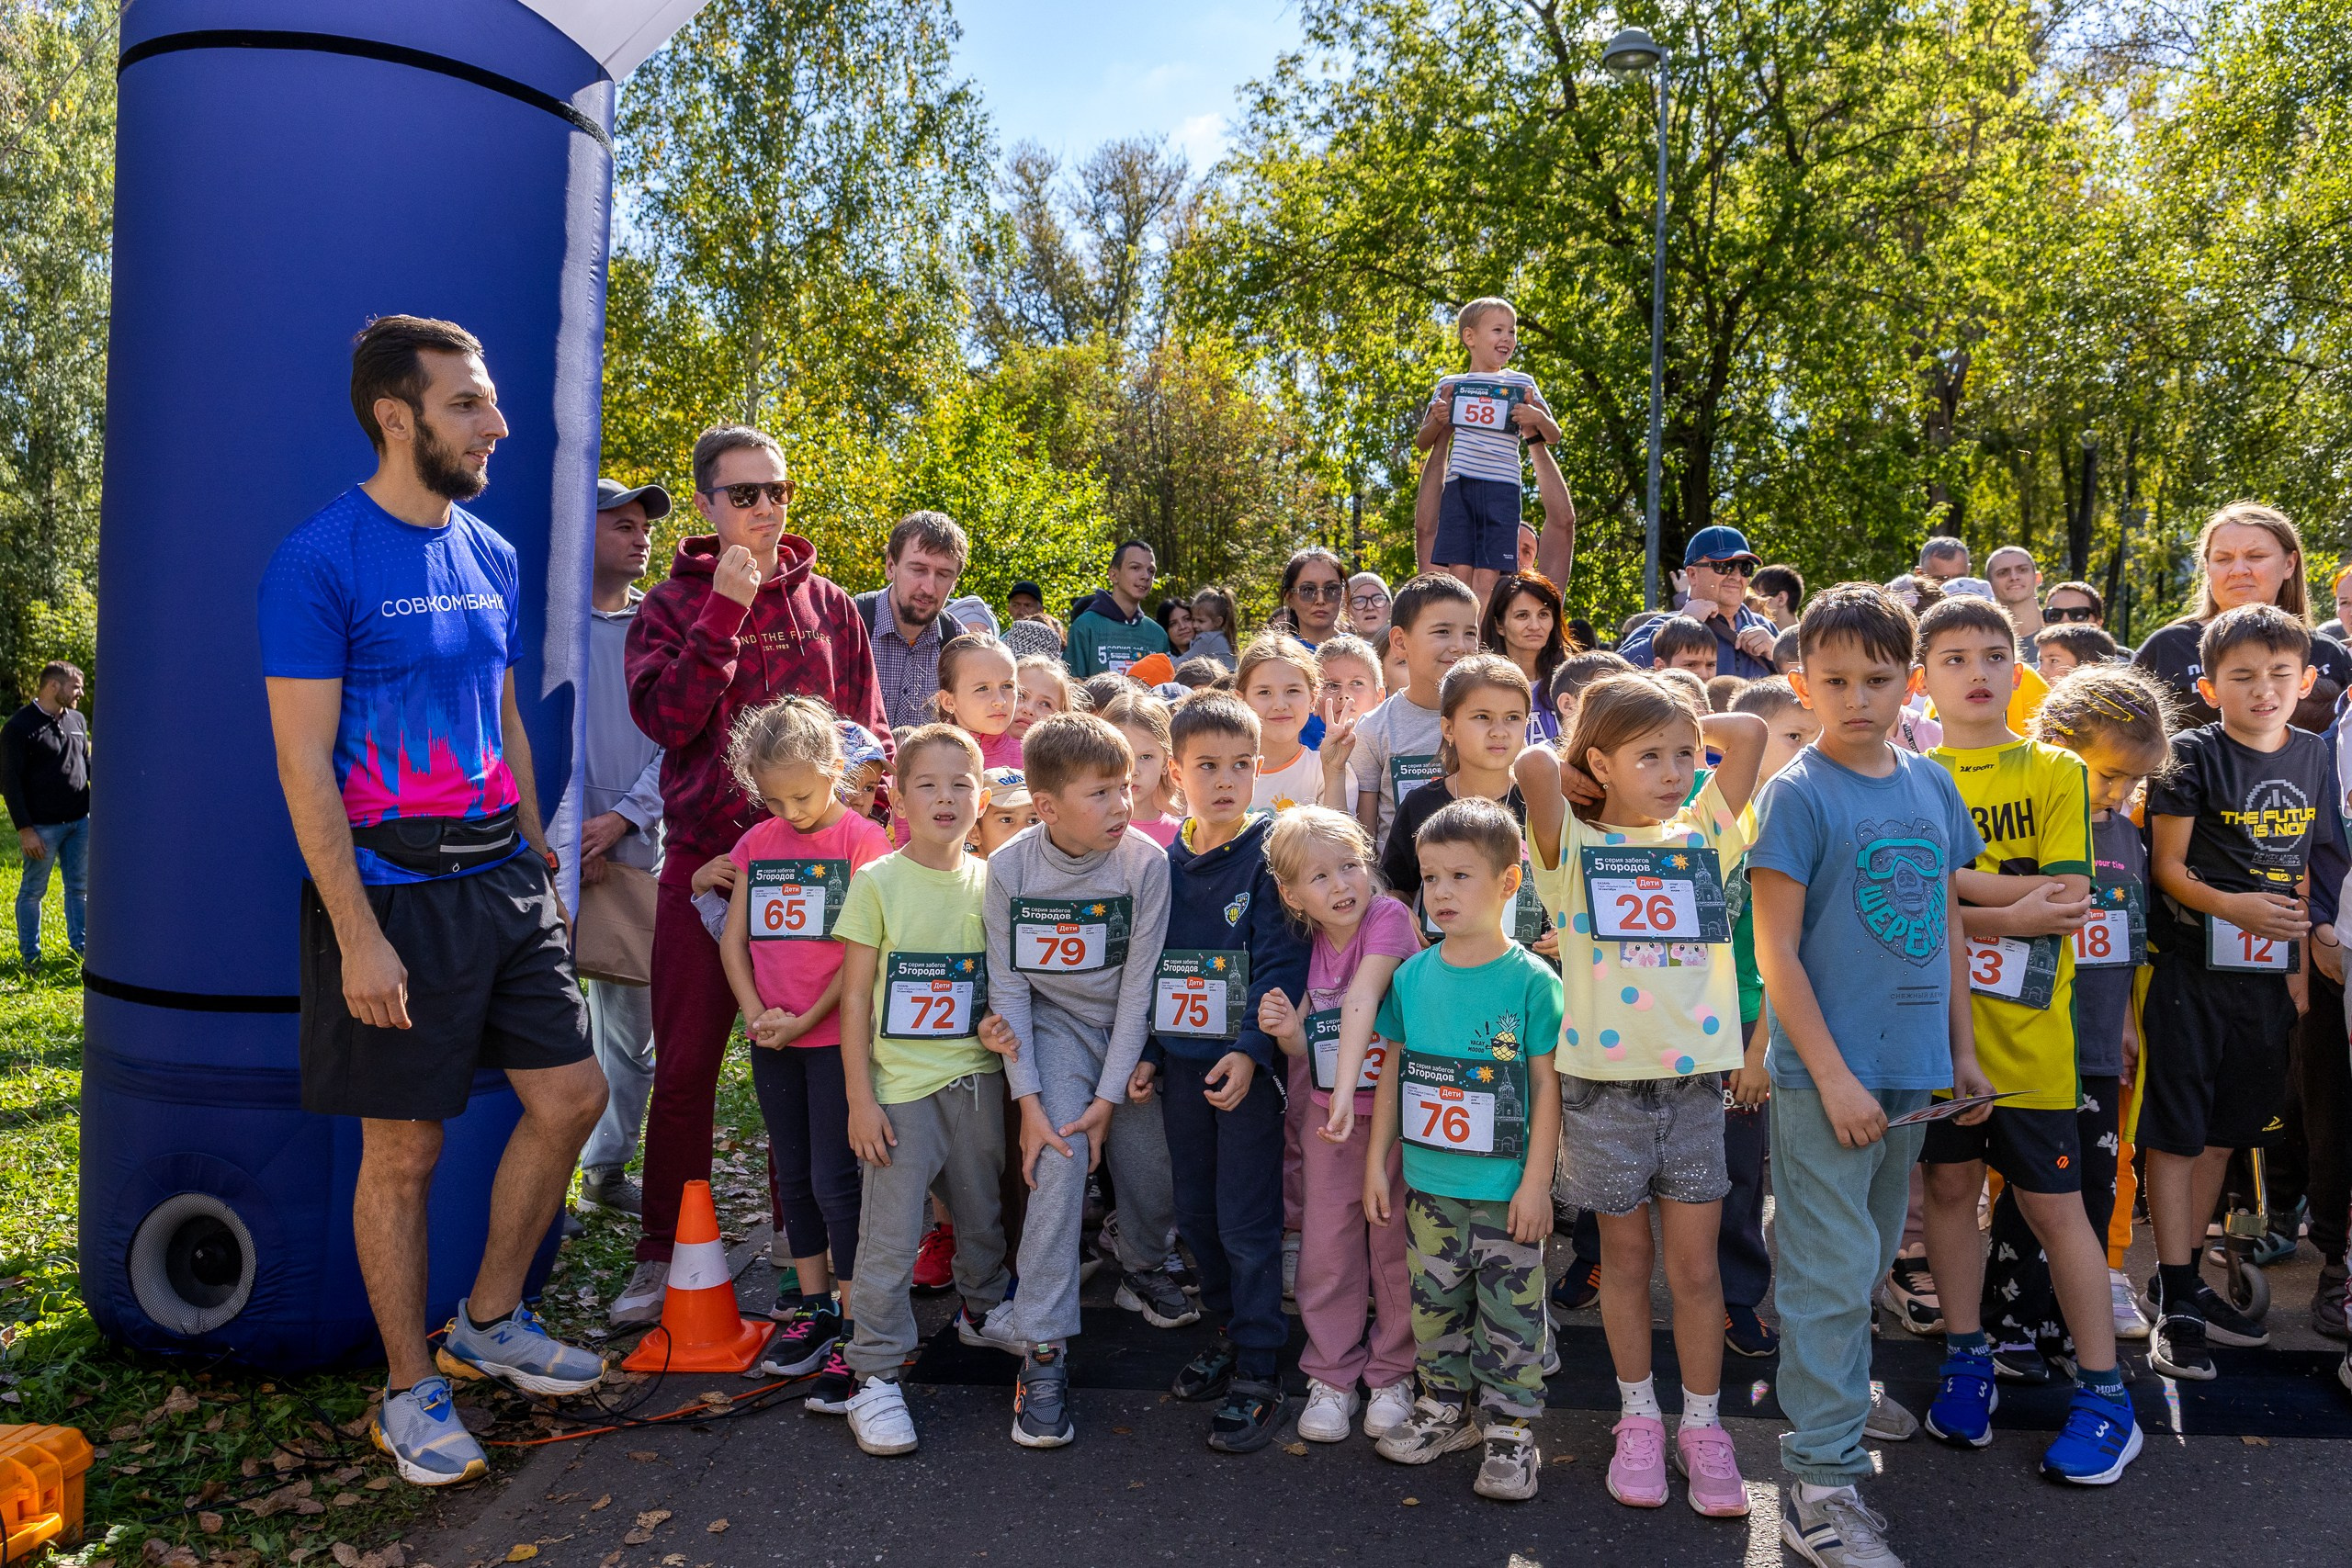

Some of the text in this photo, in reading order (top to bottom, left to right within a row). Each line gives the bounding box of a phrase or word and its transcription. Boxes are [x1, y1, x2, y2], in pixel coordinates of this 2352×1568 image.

[1464, 404, 1495, 424] 58
[381, 593, 504, 617] СОВКОМБАНК
[741, 635, 757, 645] ND
[761, 631, 786, 642] THE
[1098, 646, 1106, 664] 5
[1967, 797, 2036, 843] ЗИН
[2221, 807, 2315, 824] THE FUTUR
[2254, 822, 2306, 837] IS NOW
[764, 899, 806, 931] 65
[1616, 894, 1677, 931] 26
[1036, 937, 1086, 965] 79
[2071, 925, 2111, 958] 18
[2237, 931, 2274, 962] 12
[1966, 946, 2003, 985] 3
[910, 997, 956, 1029] 72
[1171, 993, 1209, 1027] 75
[1416, 1061, 1454, 1074] серия забегов
[1442, 1089, 1461, 1098] Дети
[1419, 1100, 1470, 1143] 76
